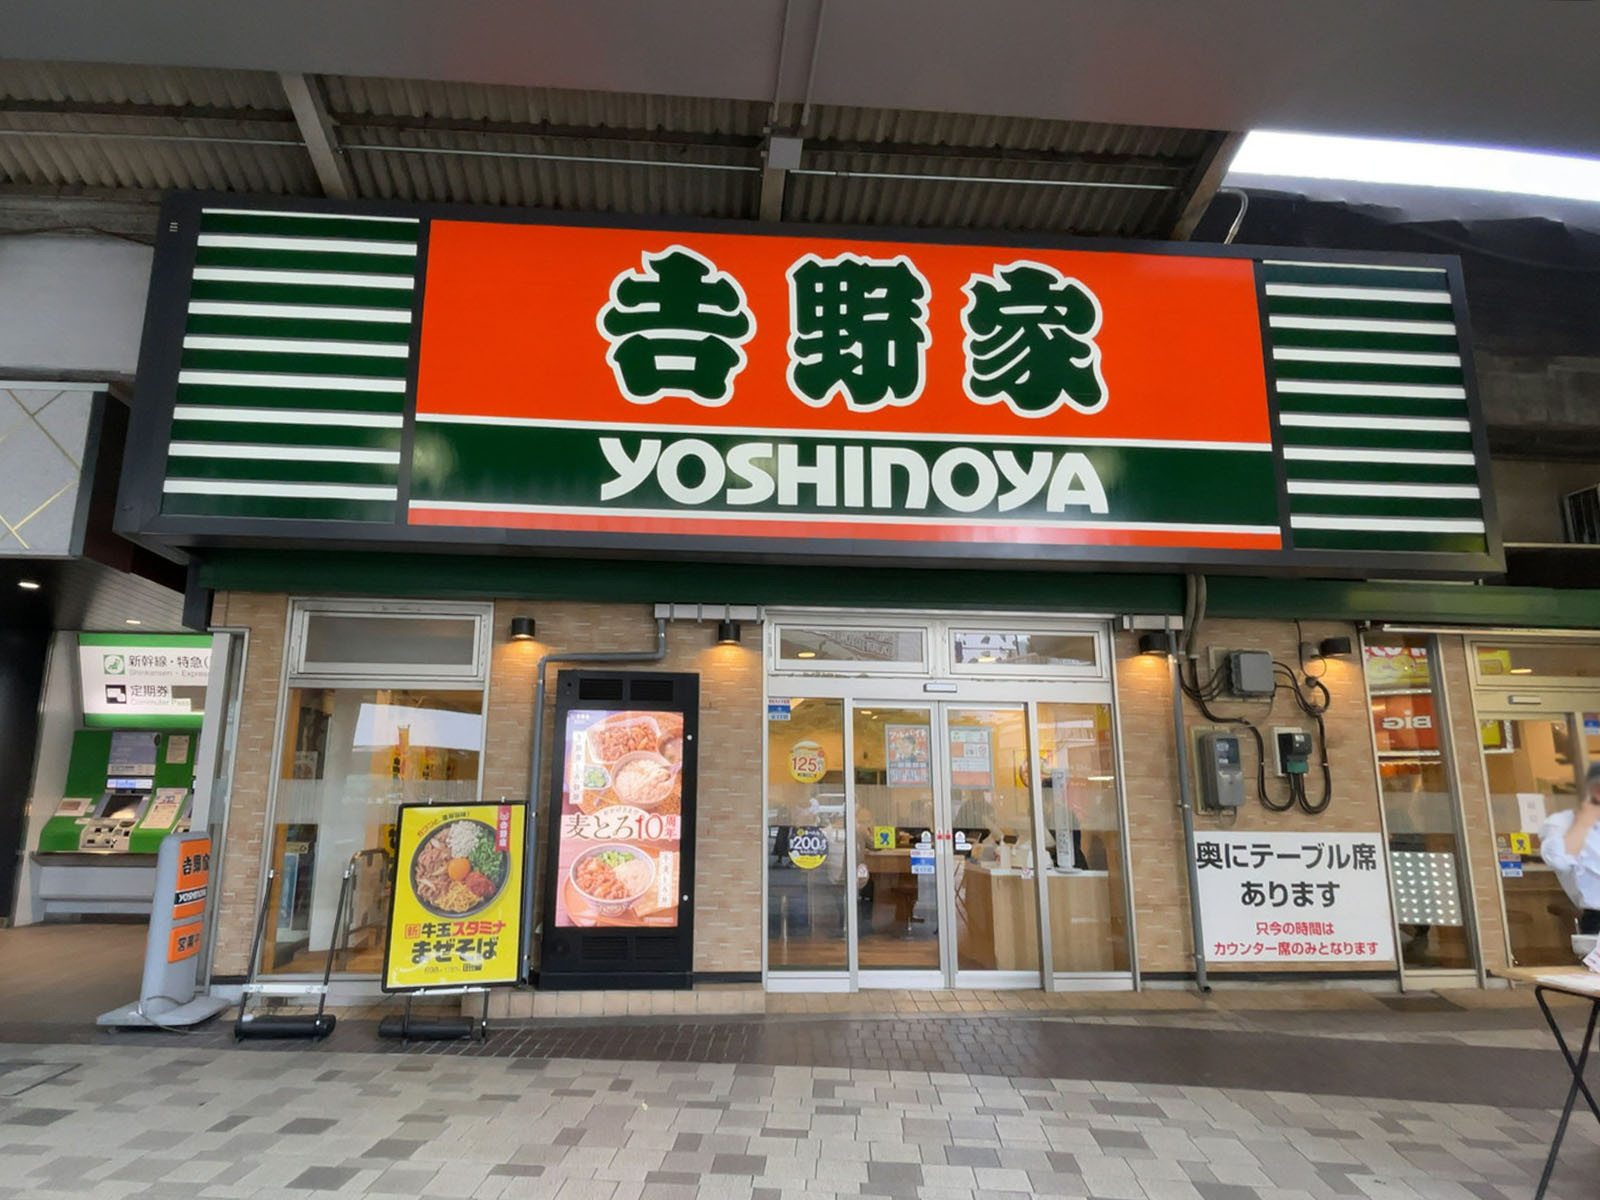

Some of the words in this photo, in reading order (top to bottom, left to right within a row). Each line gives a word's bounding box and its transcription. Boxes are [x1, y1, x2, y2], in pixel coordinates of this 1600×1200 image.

[598, 437, 1109, 514] YOSHINOYA
[130, 684, 168, 698] 定期券
[792, 756, 817, 772] 125
[1196, 841, 1377, 870] 奥にテーブル席
[1241, 881, 1341, 908] あります
[1256, 921, 1335, 936] 只今の時間は
[411, 936, 500, 964] まぜそば
[1213, 941, 1379, 956] カウンター席のみとなります
